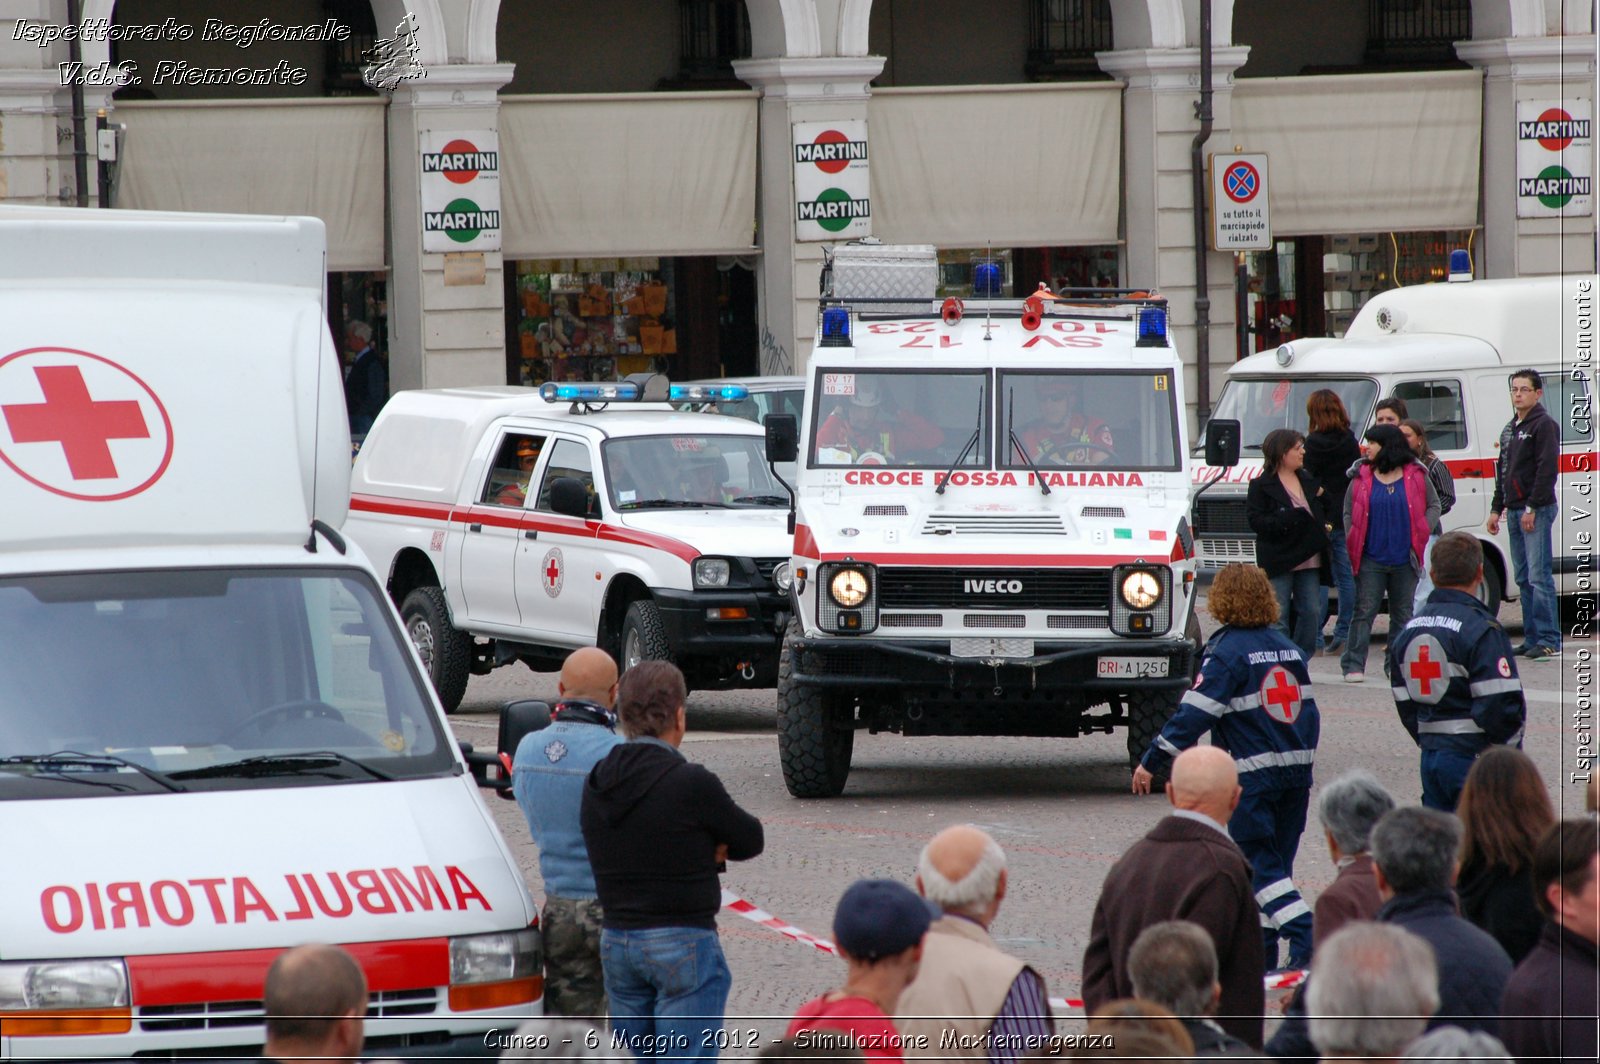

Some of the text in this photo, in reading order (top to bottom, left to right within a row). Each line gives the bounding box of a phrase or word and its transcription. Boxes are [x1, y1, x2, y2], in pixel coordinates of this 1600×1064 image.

[1521, 121, 1589, 138] MARTINI
[796, 143, 866, 161] MARTINI
[424, 153, 496, 171] MARTINI
[1521, 178, 1589, 196] MARTINI
[799, 201, 869, 219] MARTINI
[1233, 210, 1254, 219] tutto
[1255, 209, 1261, 218] il
[427, 211, 499, 230] MARTINI
[1220, 221, 1265, 231] marciapiede
[1228, 233, 1258, 242] rialzato
[826, 375, 852, 384] SV 17
[827, 385, 836, 393] 10
[844, 385, 853, 393] 23
[844, 471, 1144, 487] CROCE ROSSA ITALIANA
[964, 579, 1023, 594] IVECO
[1099, 661, 1118, 673] CRI
